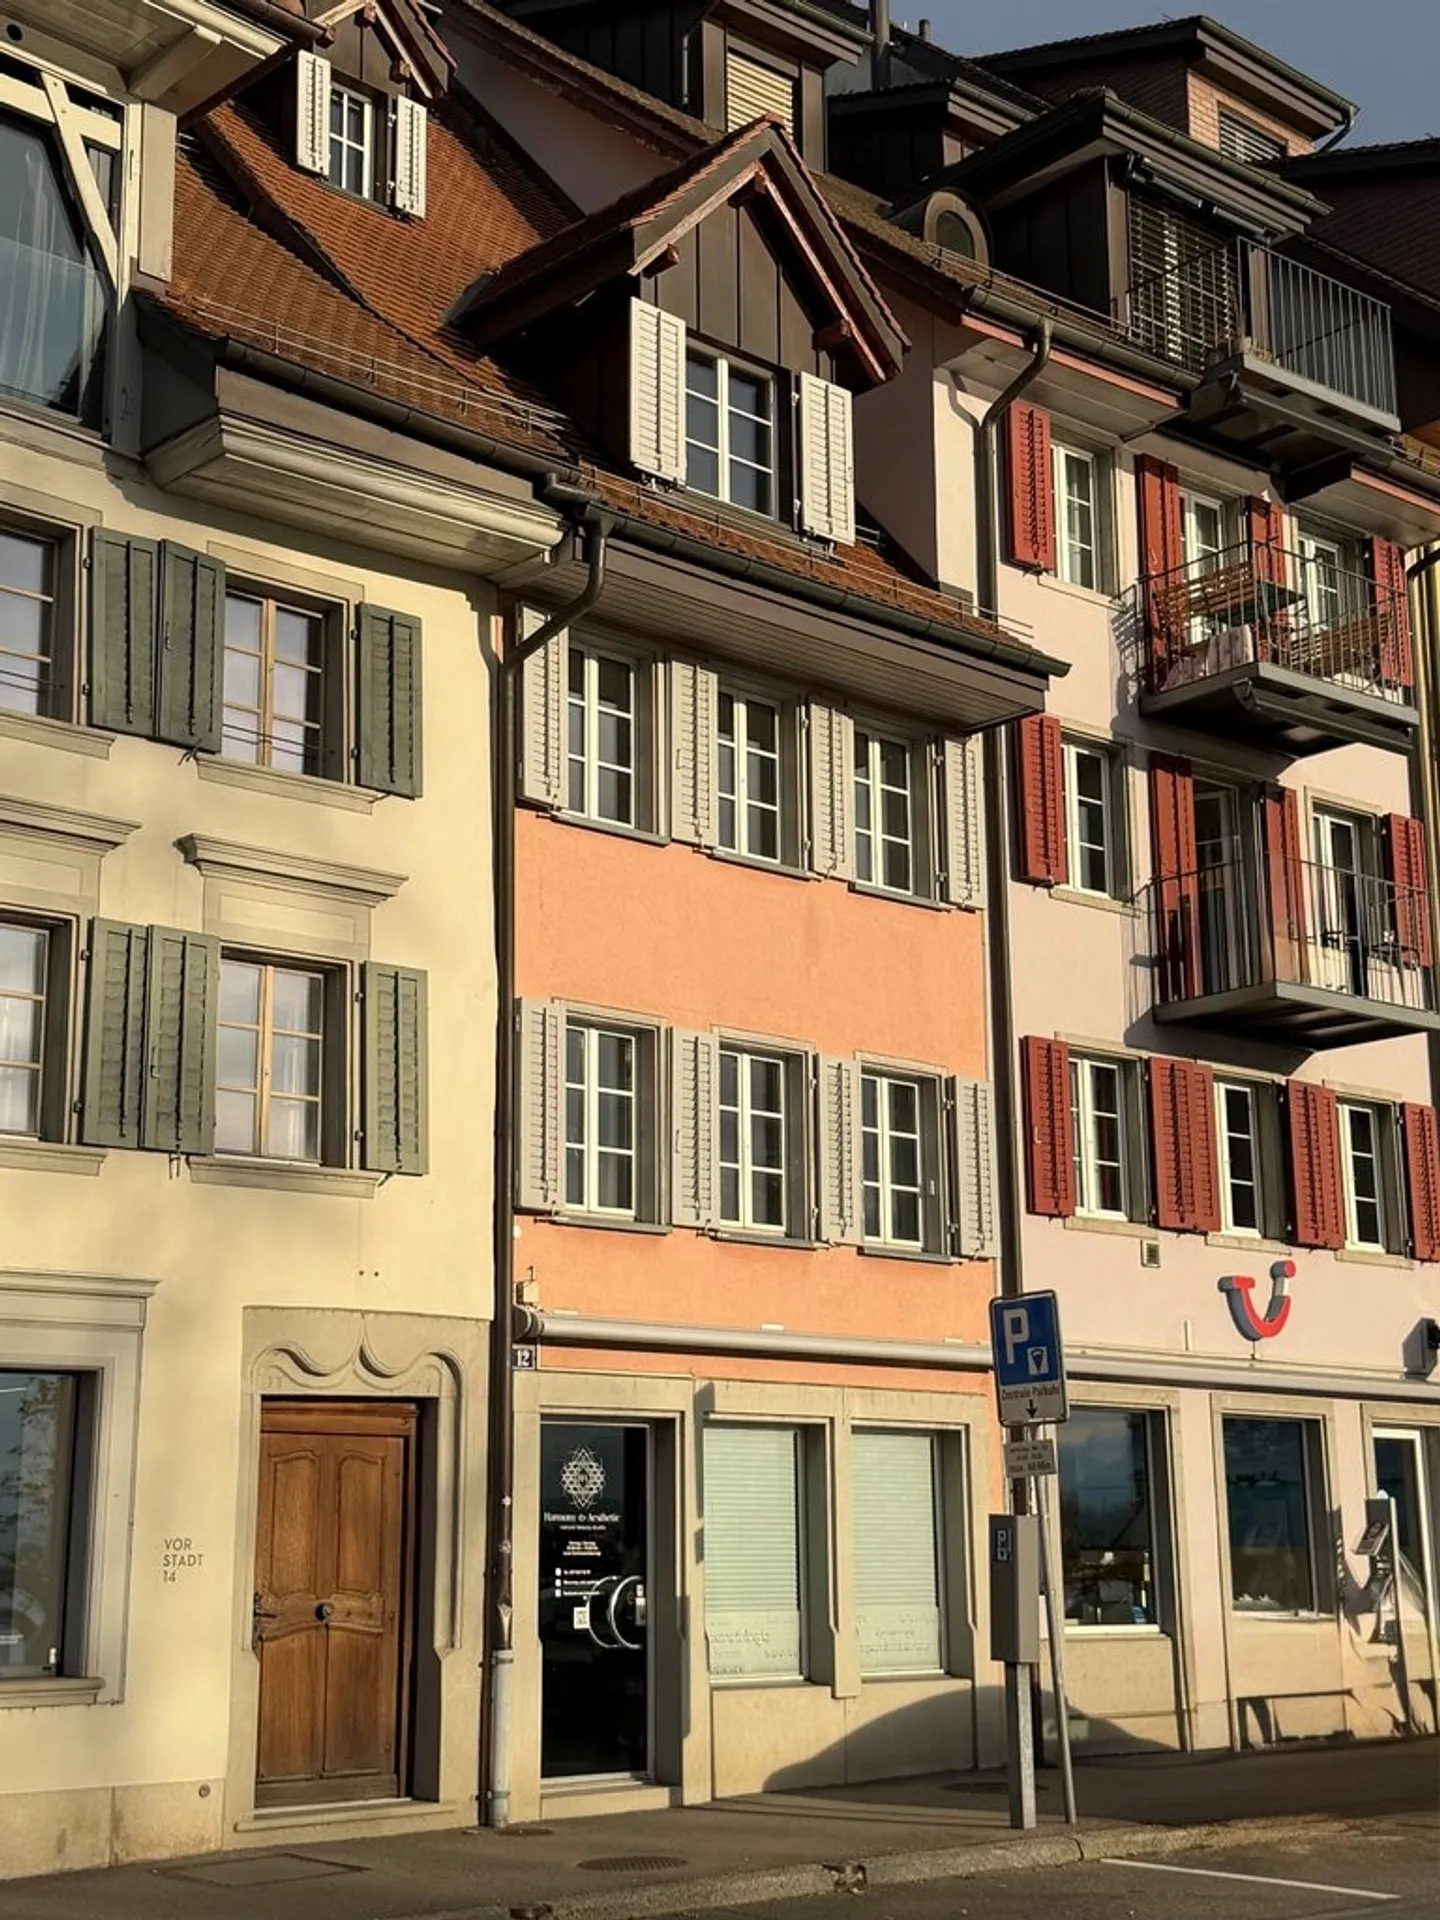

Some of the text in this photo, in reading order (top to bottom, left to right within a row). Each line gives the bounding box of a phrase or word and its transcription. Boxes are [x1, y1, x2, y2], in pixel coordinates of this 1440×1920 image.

[1003, 1308, 1030, 1364] P
[517, 1350, 530, 1366] 12
[164, 1537, 192, 1551] VOR
[163, 1553, 204, 1567] STADT
[163, 1569, 176, 1582] 14
